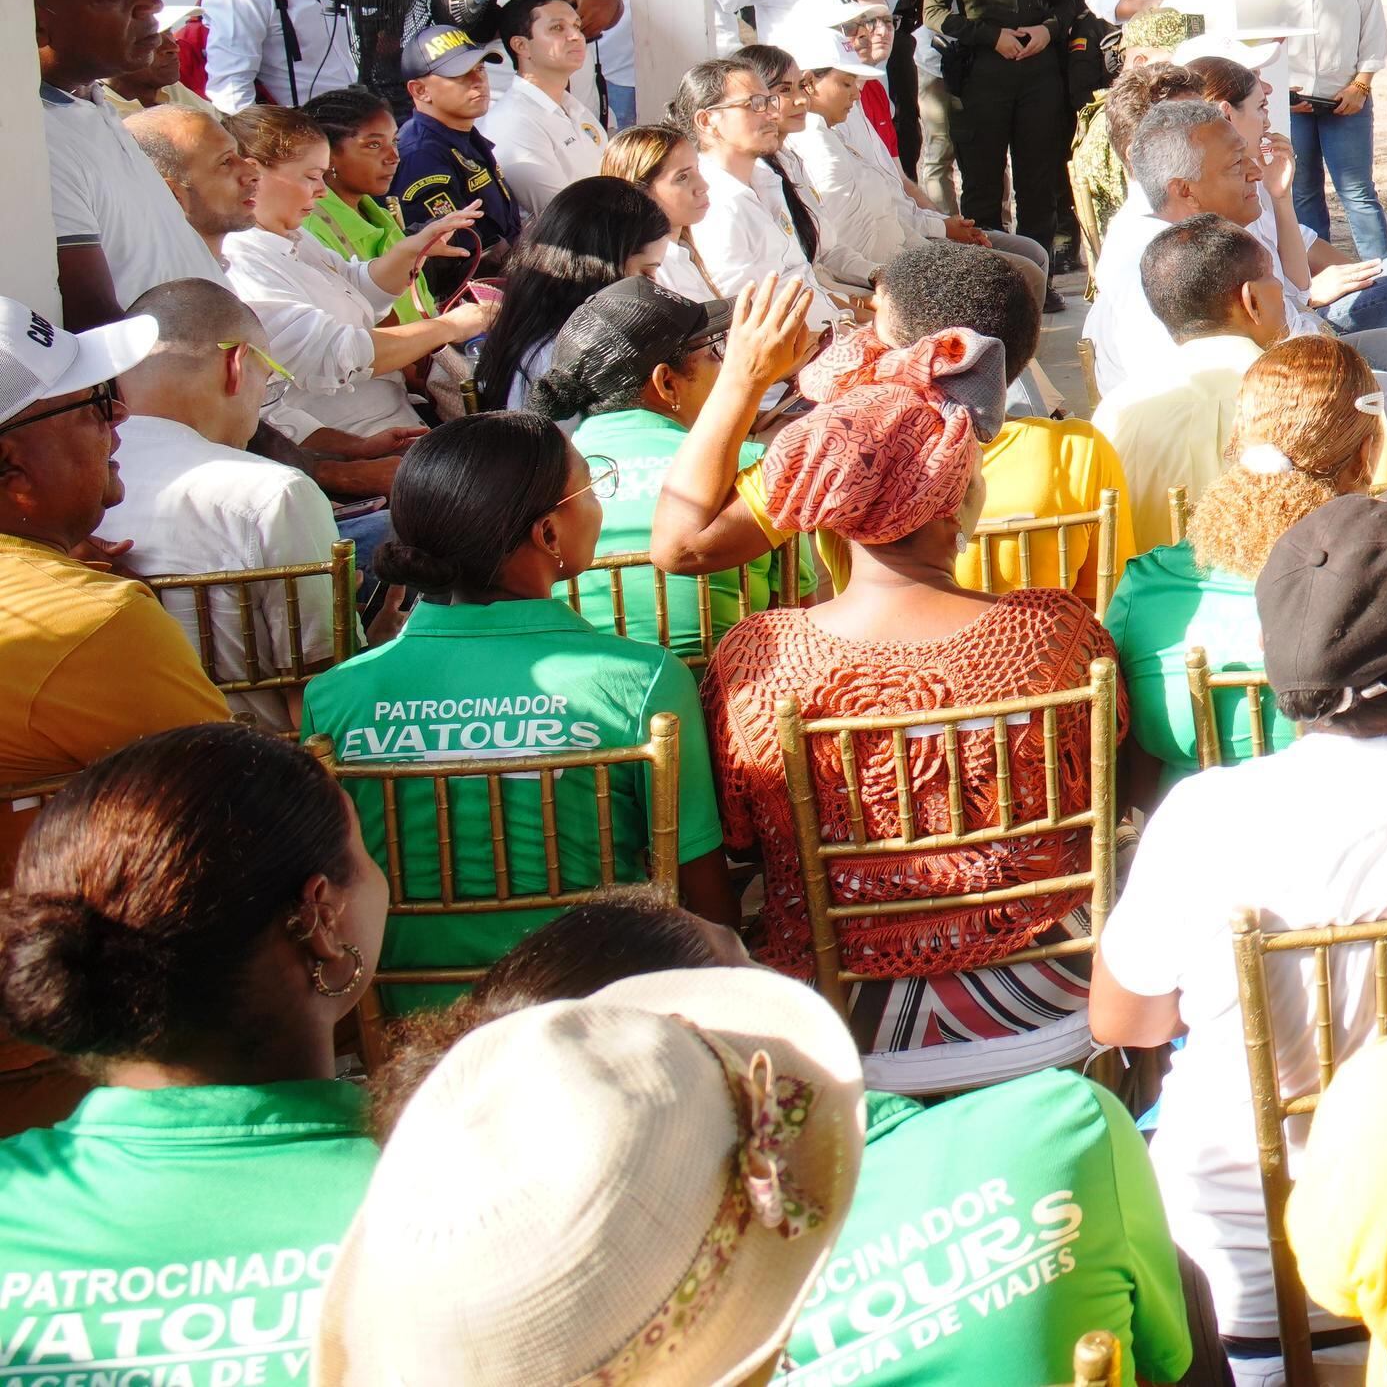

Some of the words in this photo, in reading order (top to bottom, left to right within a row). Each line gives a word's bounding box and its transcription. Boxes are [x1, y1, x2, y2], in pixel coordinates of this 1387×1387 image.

[342, 719, 601, 758] EVATOURS
[375, 694, 567, 721] PATROCINADOR
[791, 1190, 1083, 1358] TOURS
[908, 1305, 962, 1350] DE
[968, 1247, 1076, 1317] VIAJES
